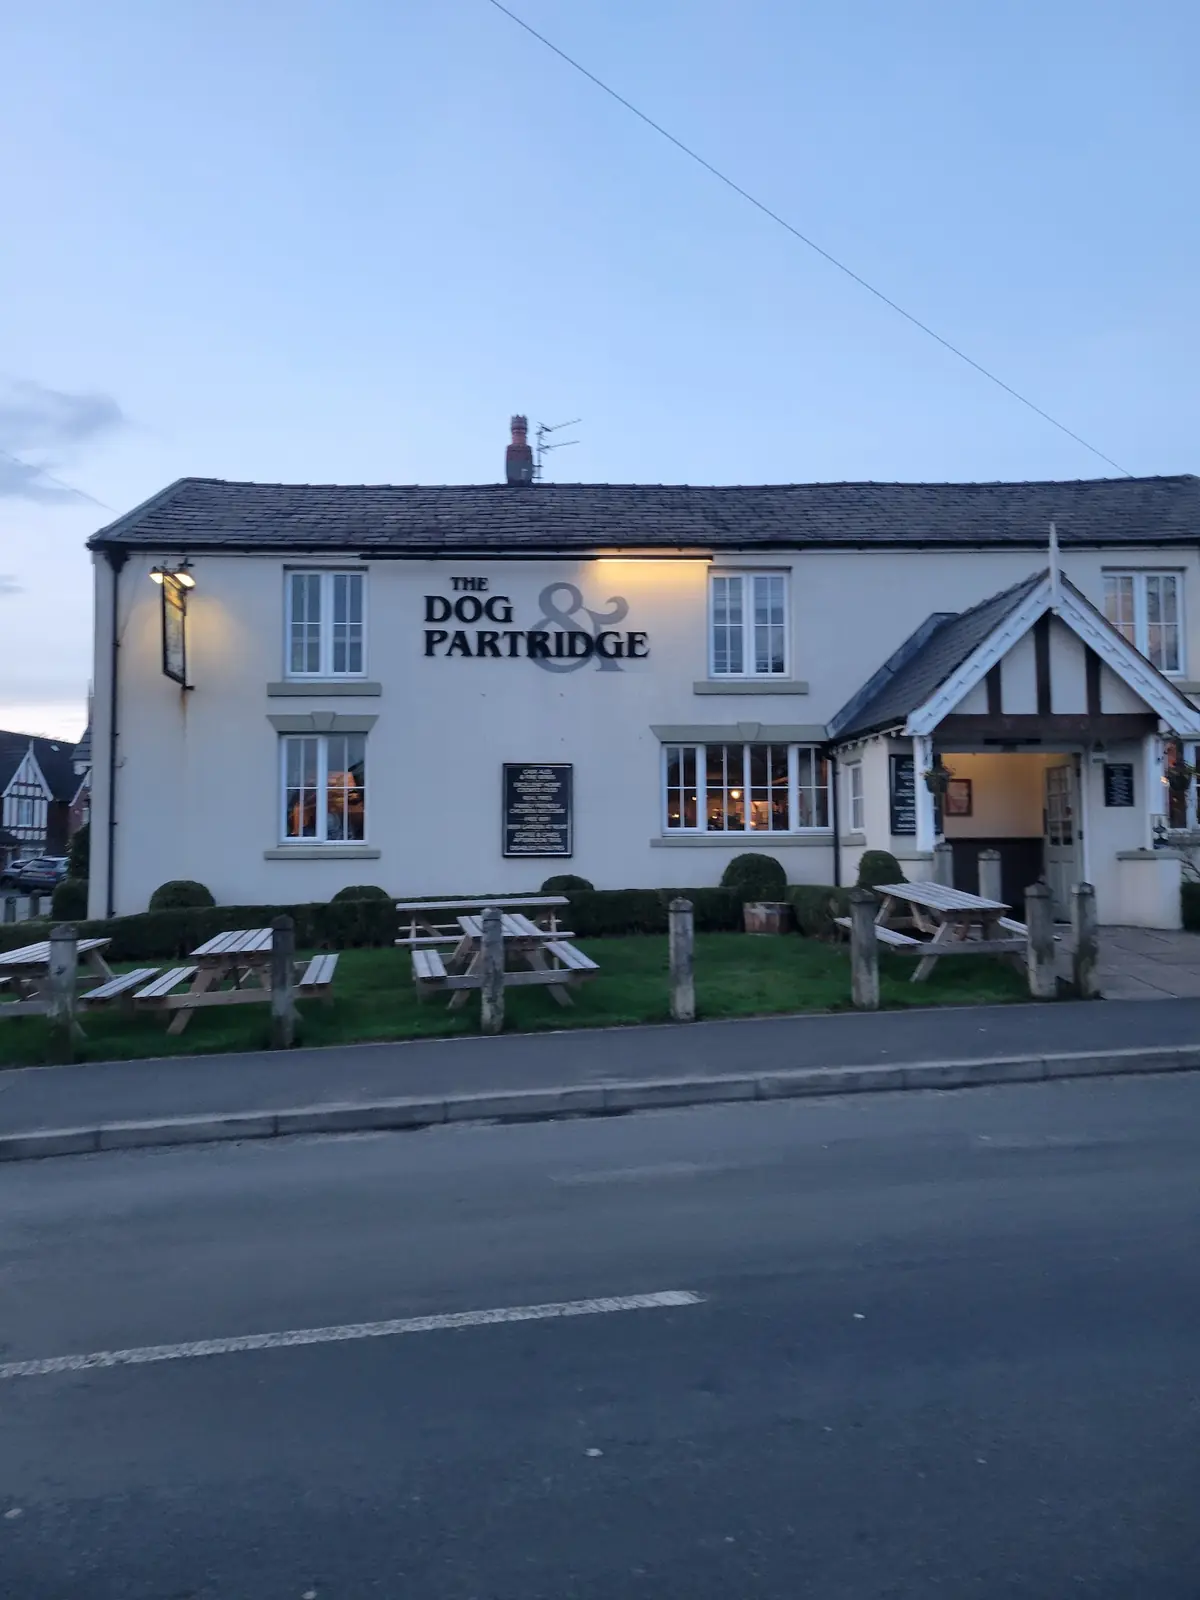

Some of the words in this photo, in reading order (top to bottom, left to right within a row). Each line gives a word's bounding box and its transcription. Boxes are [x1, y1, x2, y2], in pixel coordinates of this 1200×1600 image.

[451, 577, 489, 591] THE
[424, 595, 514, 623] DOG
[527, 581, 629, 673] &
[424, 630, 650, 658] PARTRIDGE
